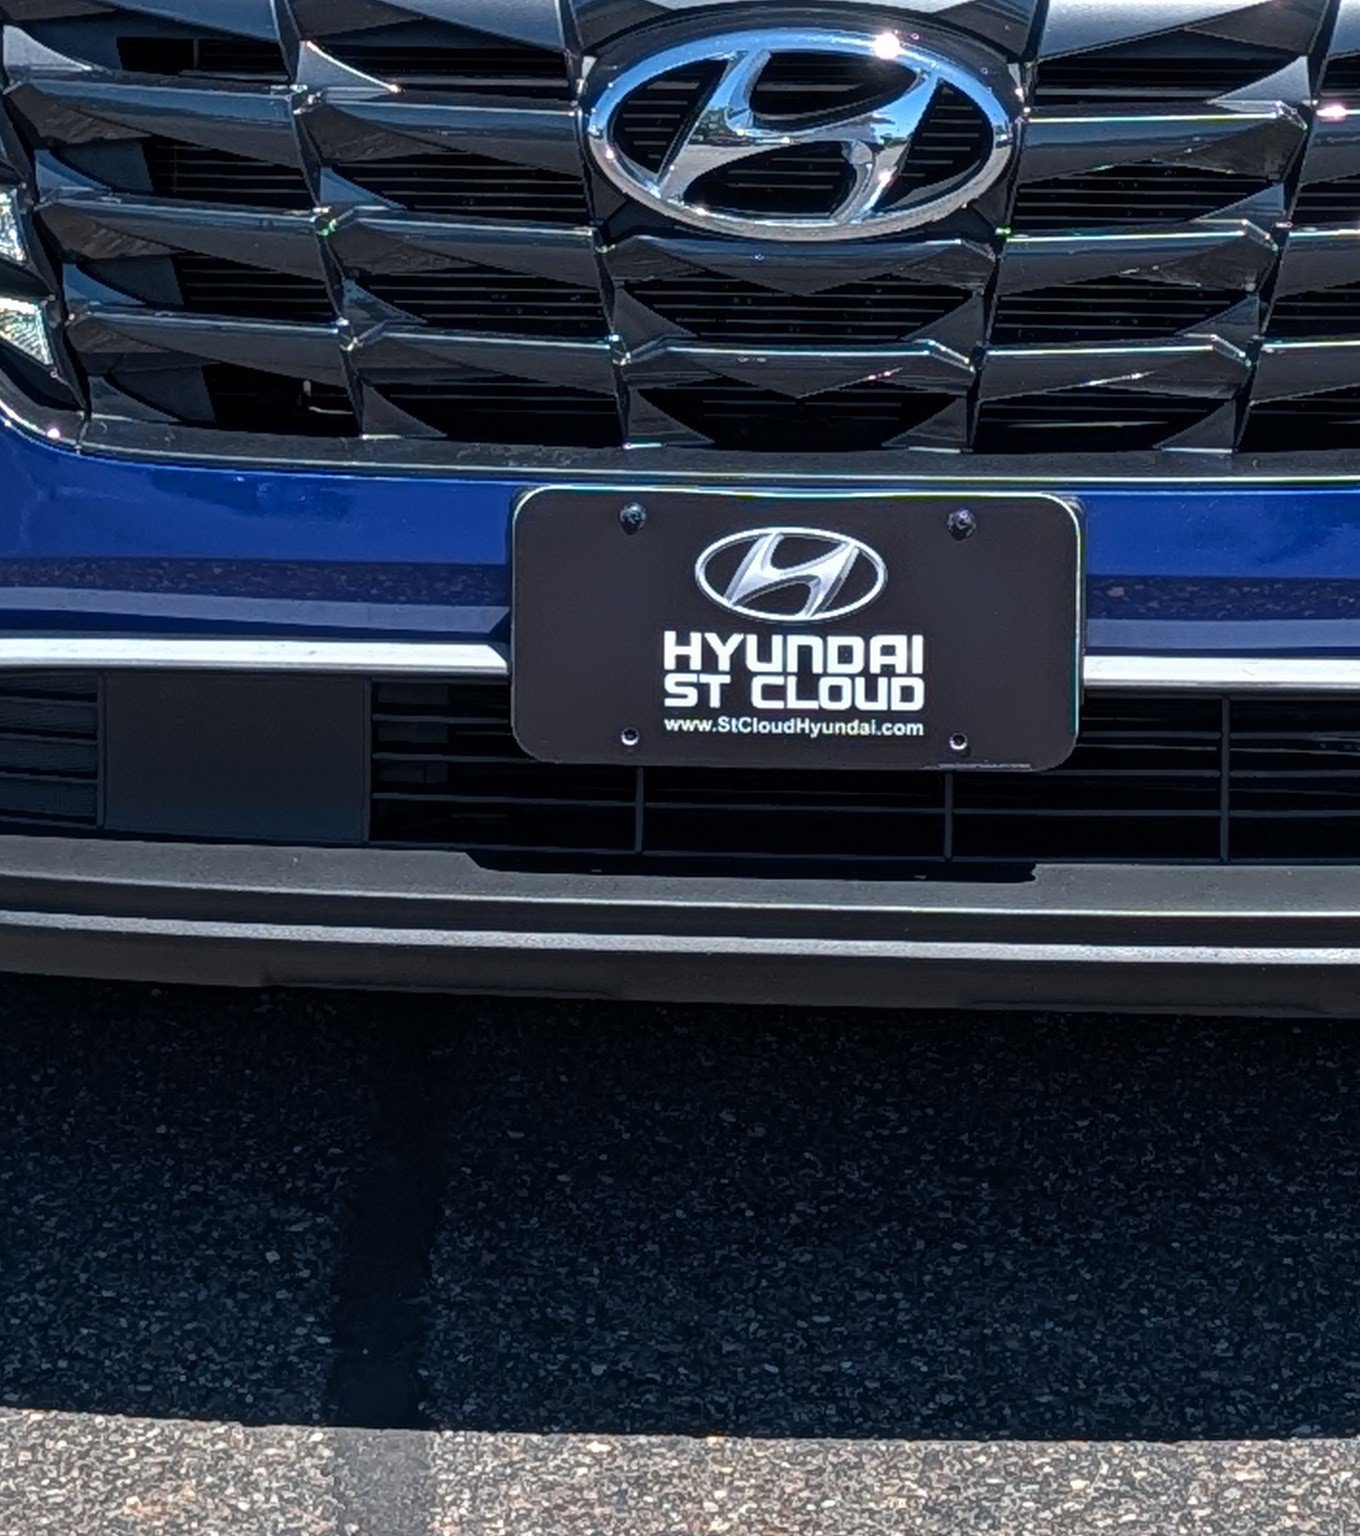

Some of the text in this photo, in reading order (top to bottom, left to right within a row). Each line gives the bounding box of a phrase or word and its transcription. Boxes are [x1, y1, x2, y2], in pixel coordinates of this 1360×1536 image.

[664, 630, 924, 674] HYUNDAI
[664, 673, 925, 711] ST CLOUD
[664, 716, 924, 738] www.StCloudHyundai.com
